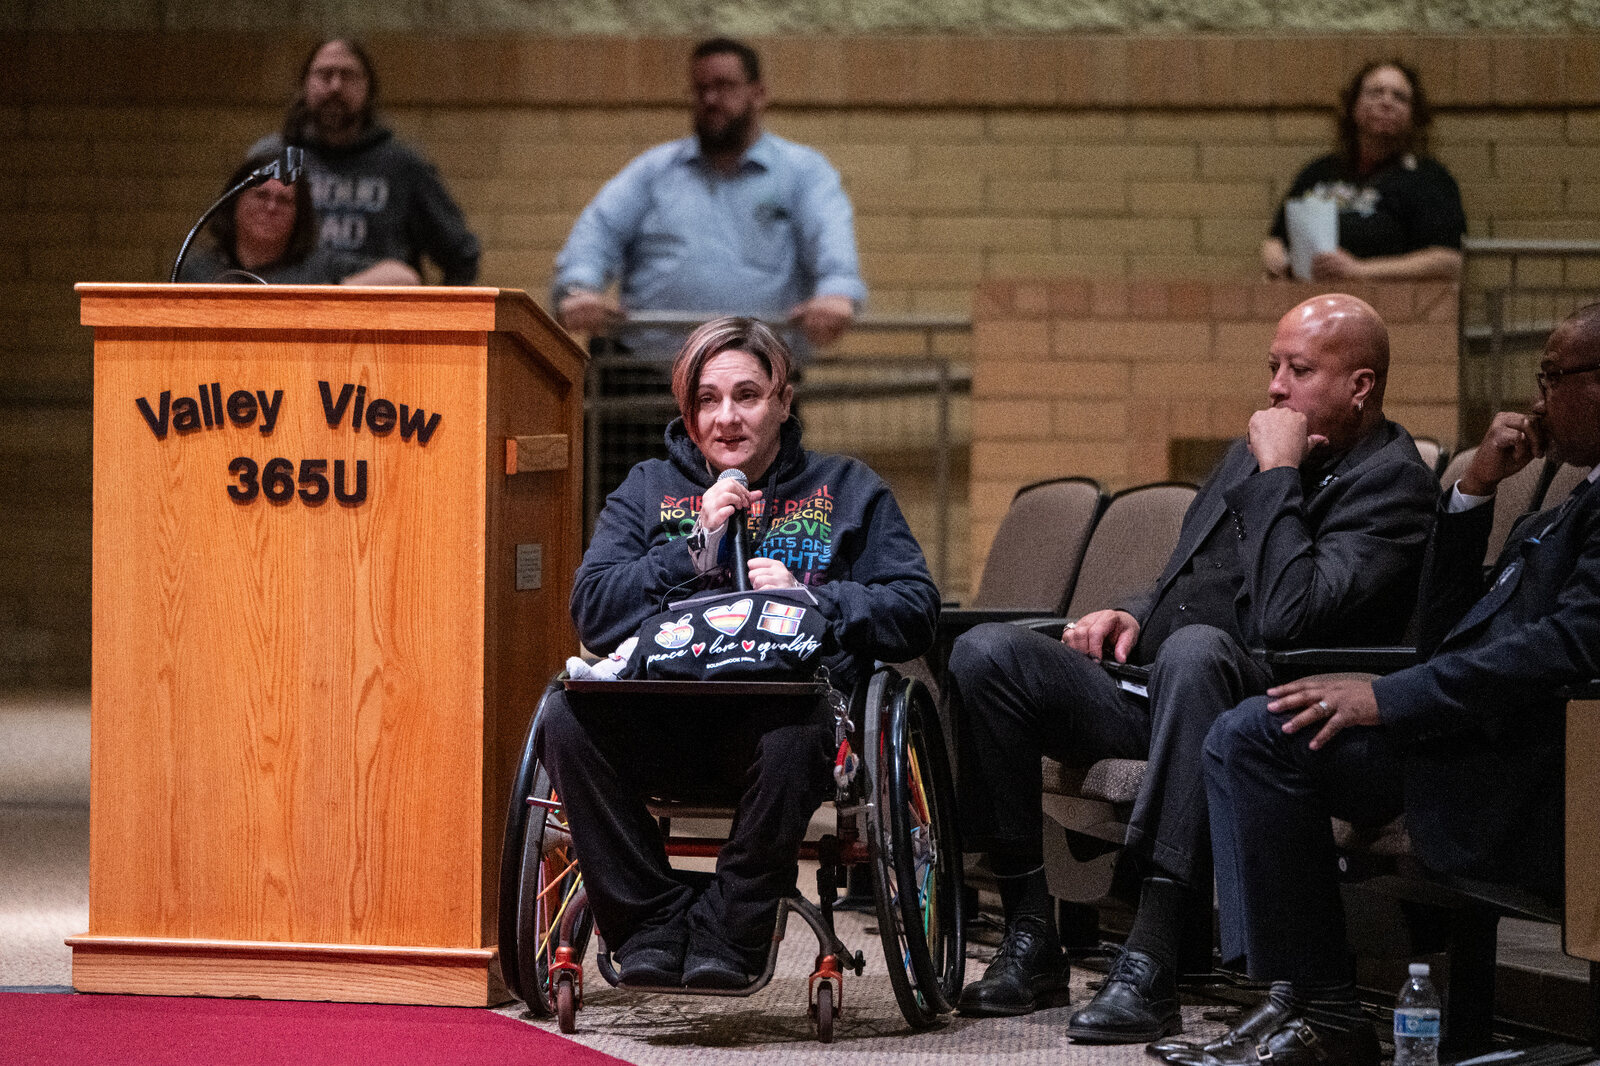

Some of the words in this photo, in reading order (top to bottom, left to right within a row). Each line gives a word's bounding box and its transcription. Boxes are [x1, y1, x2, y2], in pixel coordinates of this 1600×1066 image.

[135, 382, 284, 441] Valley
[318, 380, 442, 446] View
[227, 456, 368, 504] 365U
[660, 508, 686, 522] NO
[664, 518, 697, 539] LO
[765, 519, 832, 544] LOVE
[802, 538, 832, 555] ARE
[647, 648, 689, 670] peace
[709, 634, 739, 654] love
[757, 633, 822, 661] equality
